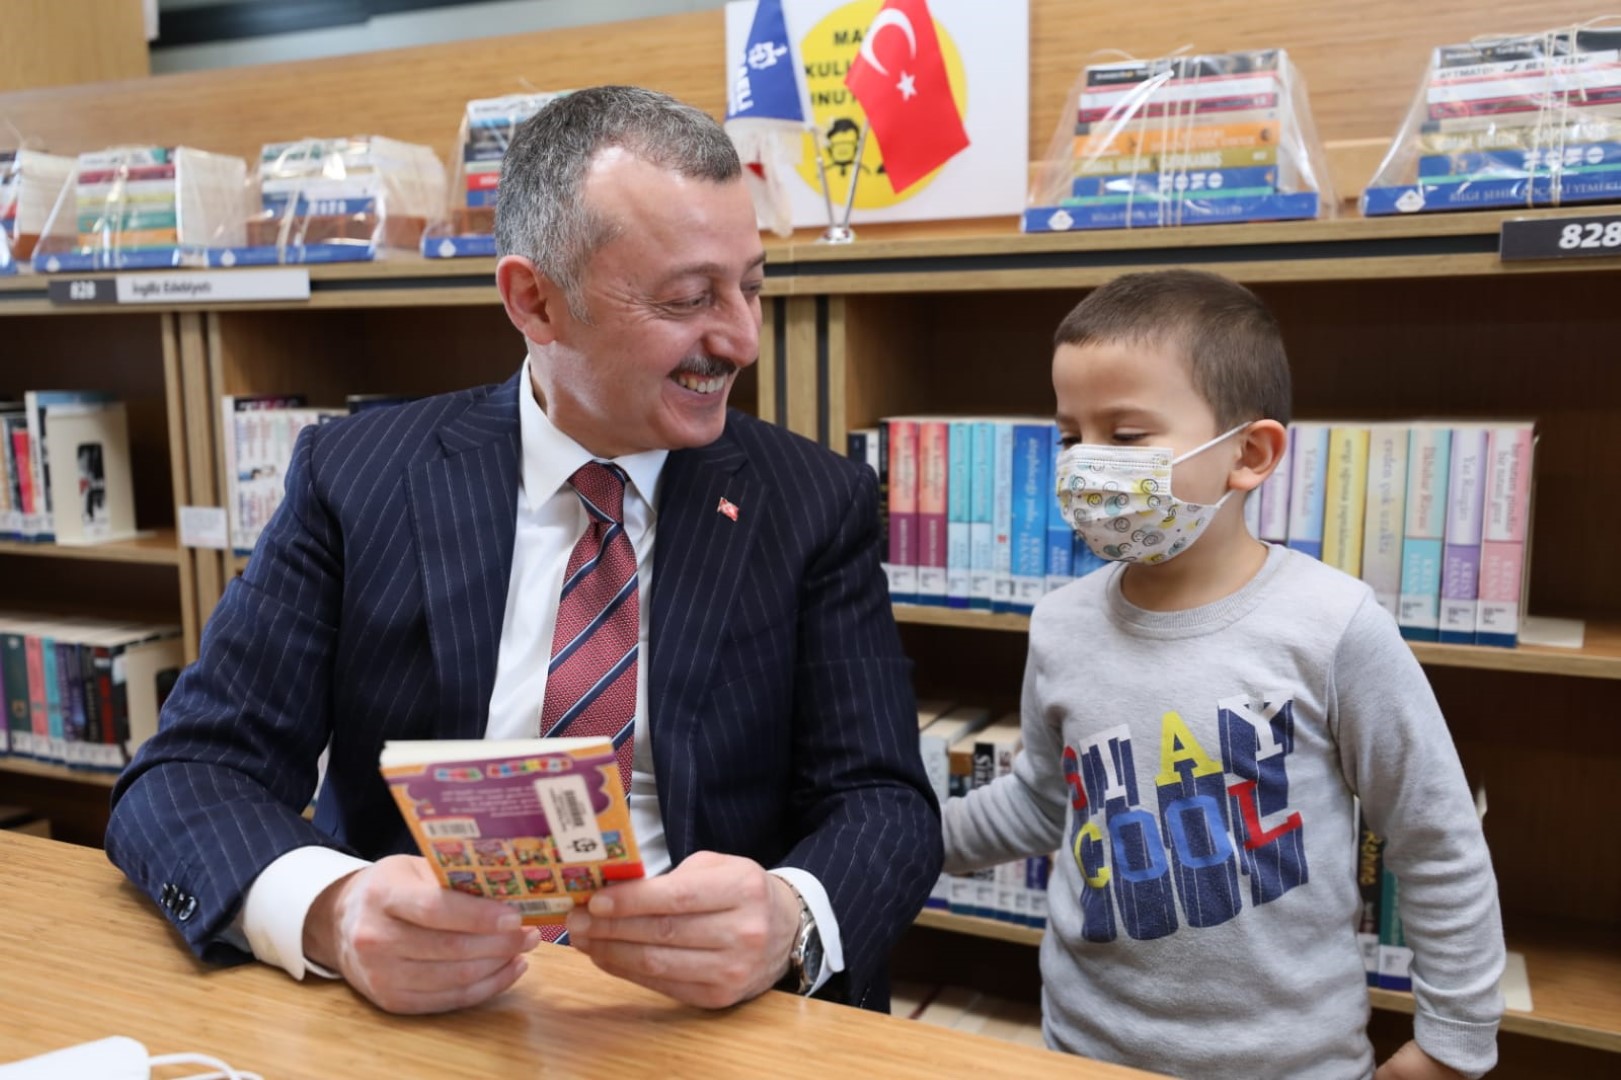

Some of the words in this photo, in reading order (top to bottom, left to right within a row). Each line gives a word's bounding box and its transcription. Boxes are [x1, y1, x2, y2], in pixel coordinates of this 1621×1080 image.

[834, 29, 863, 45] MA
[1559, 222, 1621, 249] 828
[1382, 438, 1397, 478] evden
[1378, 482, 1394, 504] çok
[1061, 693, 1294, 812] STAY
[1074, 779, 1305, 889] COOL
